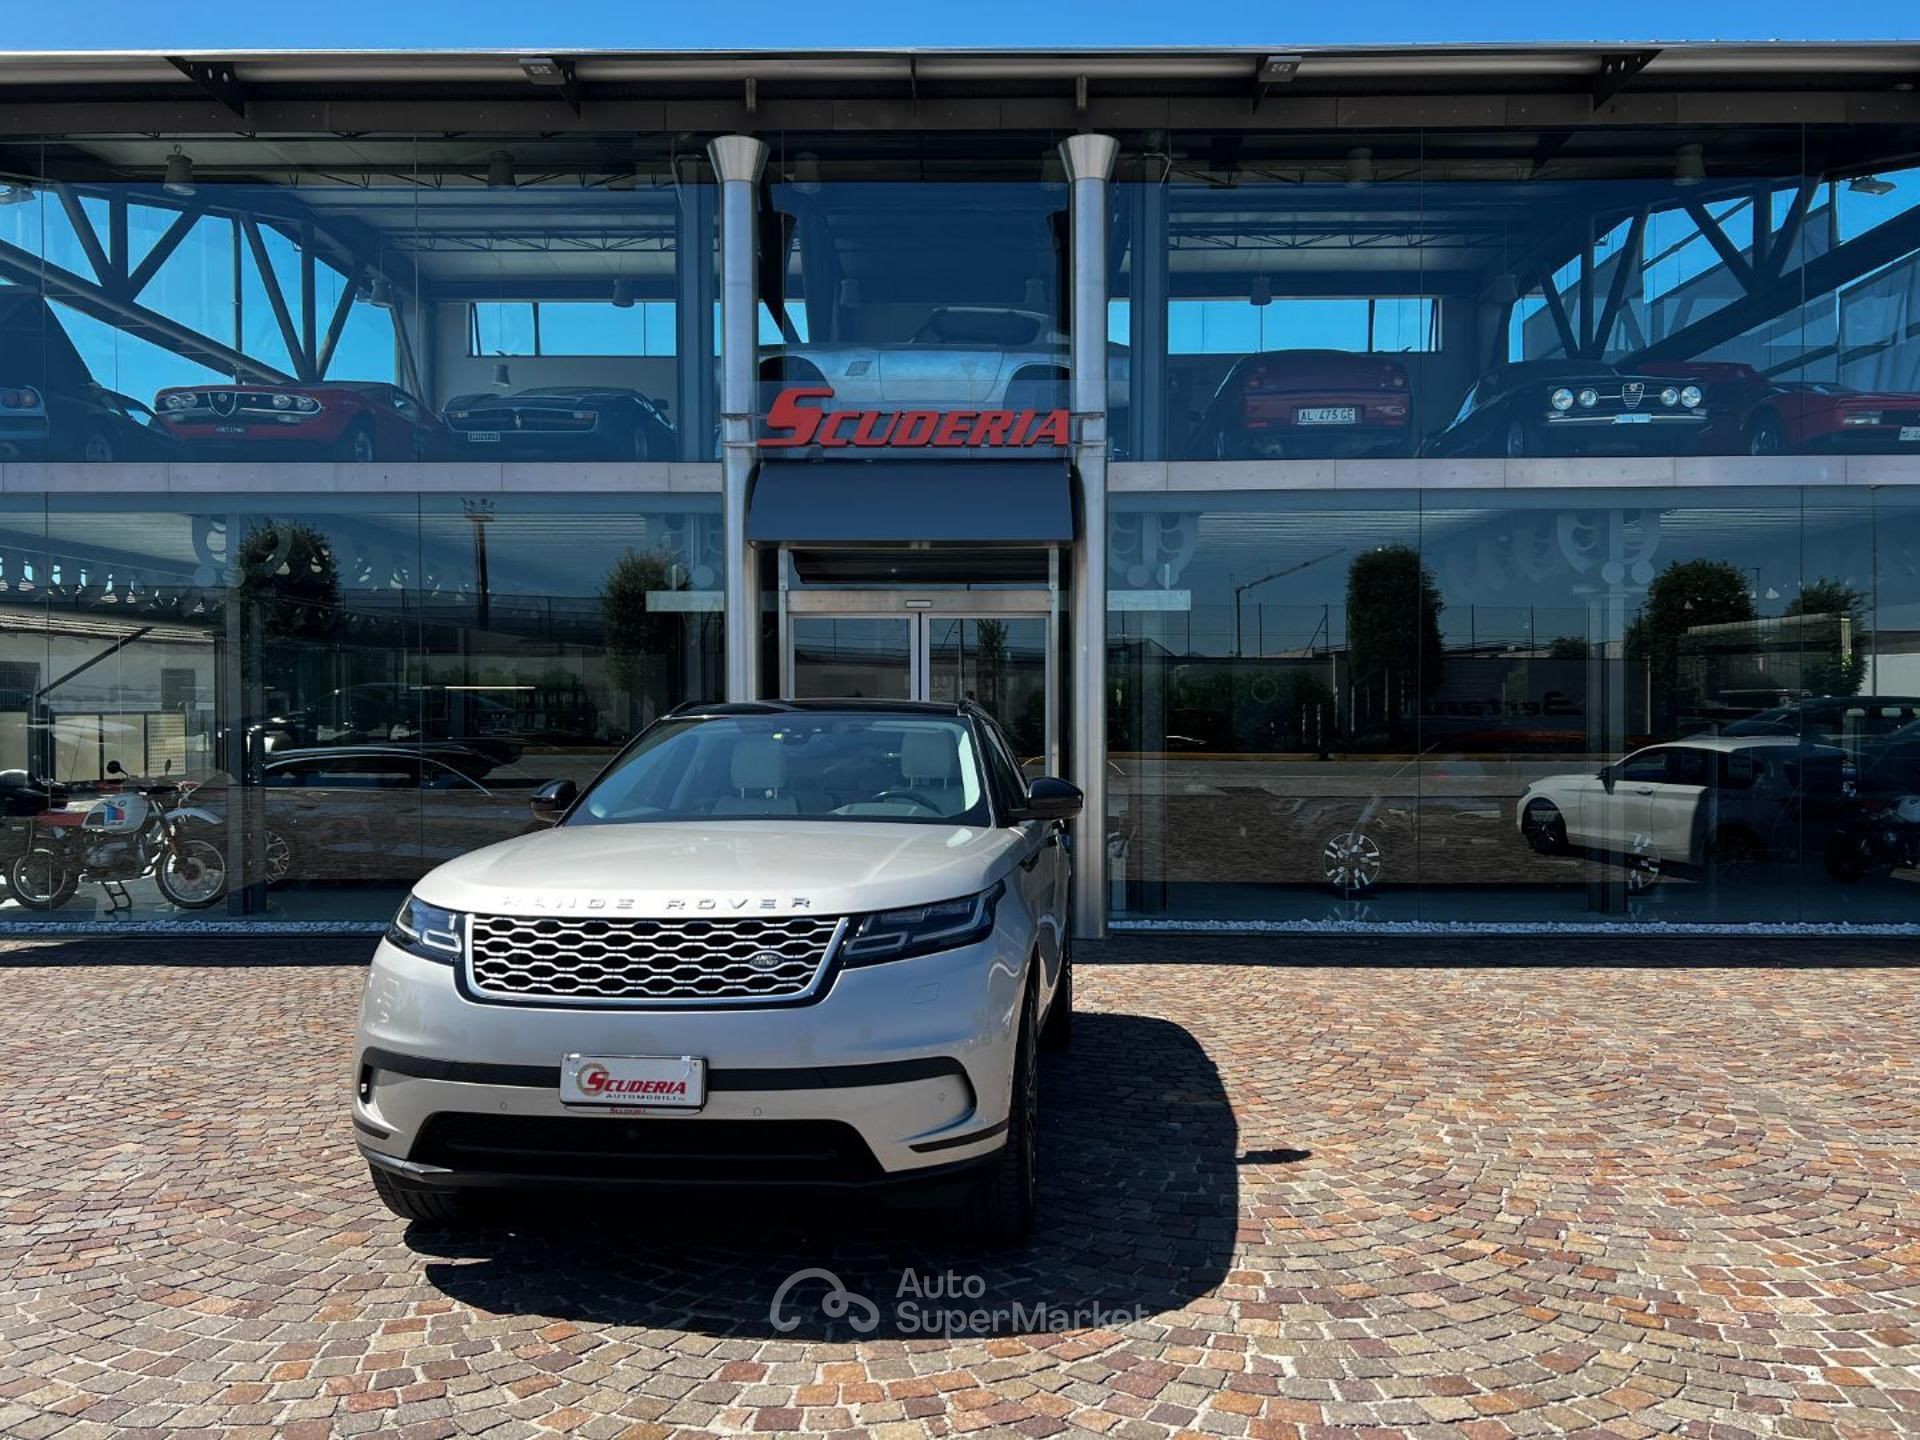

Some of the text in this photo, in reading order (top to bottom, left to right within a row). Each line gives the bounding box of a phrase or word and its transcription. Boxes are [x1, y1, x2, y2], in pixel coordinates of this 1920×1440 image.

[757, 387, 1069, 447] SCUDERIA
[666, 897, 810, 910] ROVER
[582, 1071, 686, 1095] SCUDERIA
